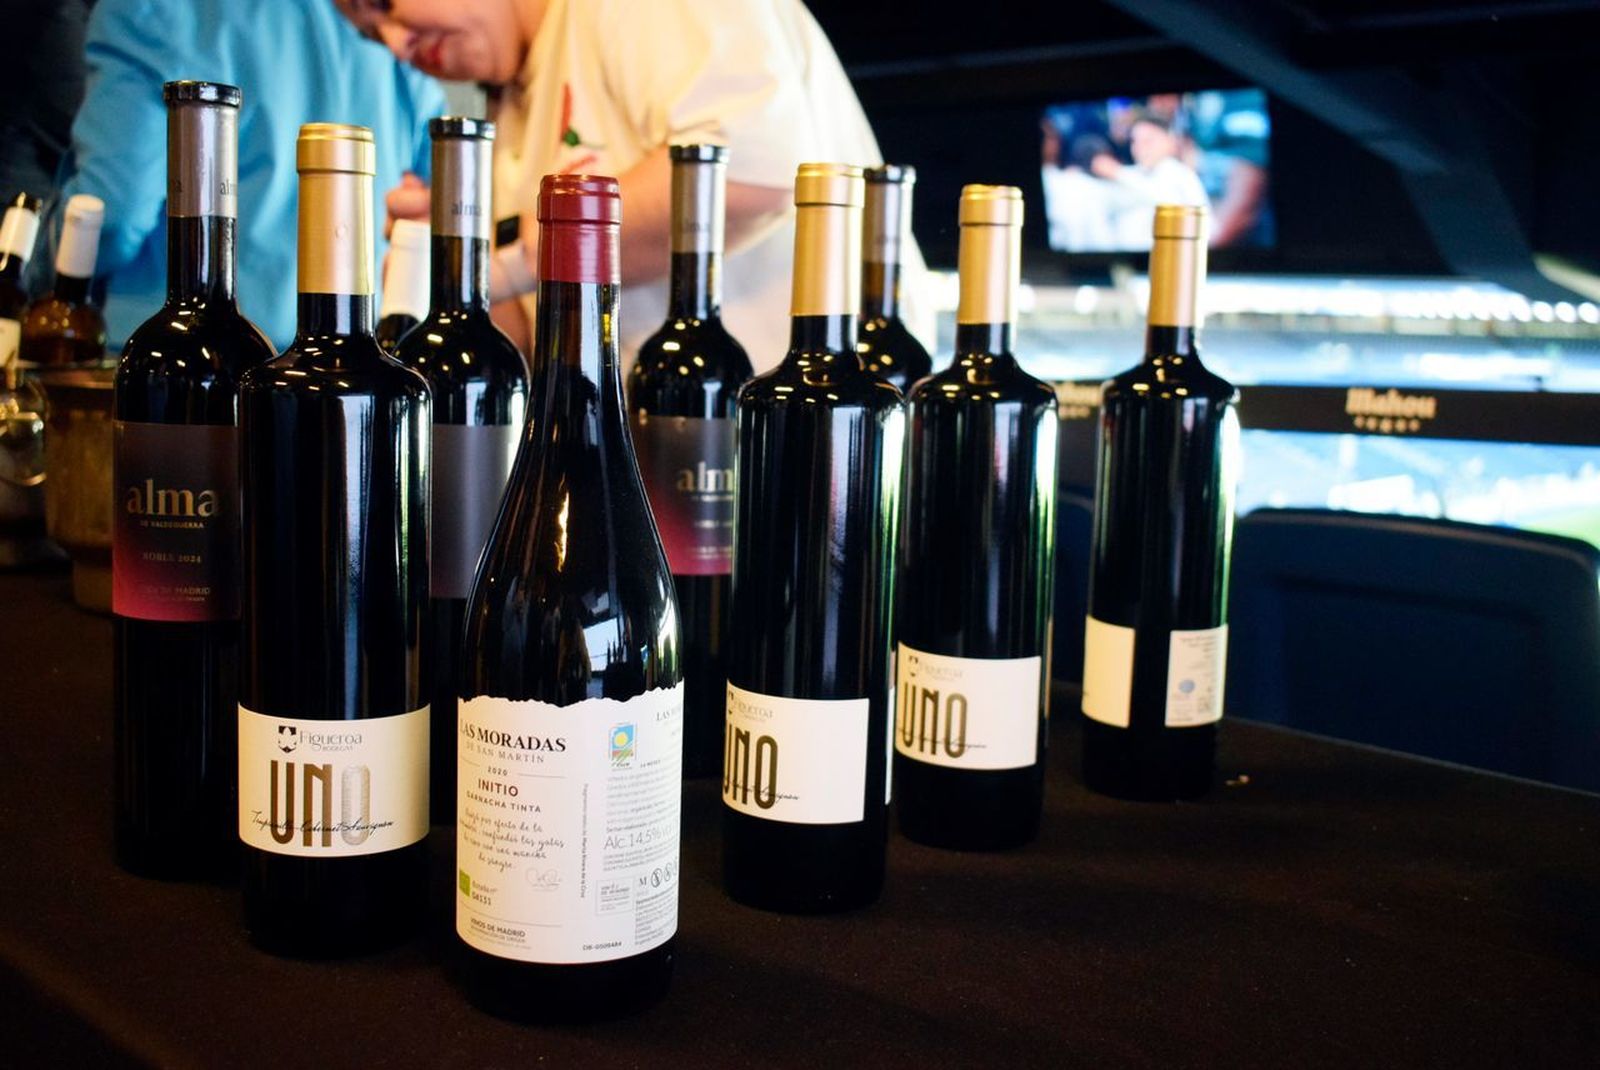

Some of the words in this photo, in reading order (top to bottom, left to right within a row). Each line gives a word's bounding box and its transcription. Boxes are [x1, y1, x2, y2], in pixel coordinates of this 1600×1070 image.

[677, 461, 734, 492] alm
[127, 478, 219, 517] alma
[902, 682, 967, 758] UNO
[299, 729, 363, 751] Figueroa
[459, 718, 476, 740] LAS
[477, 726, 567, 753] MORADAS
[487, 765, 509, 776] 2020
[466, 789, 507, 809] GARNACHA
[510, 802, 541, 813] TINTA
[478, 778, 519, 798] INITIO
[270, 760, 371, 847] UNO
[496, 926, 526, 938] MADRID
